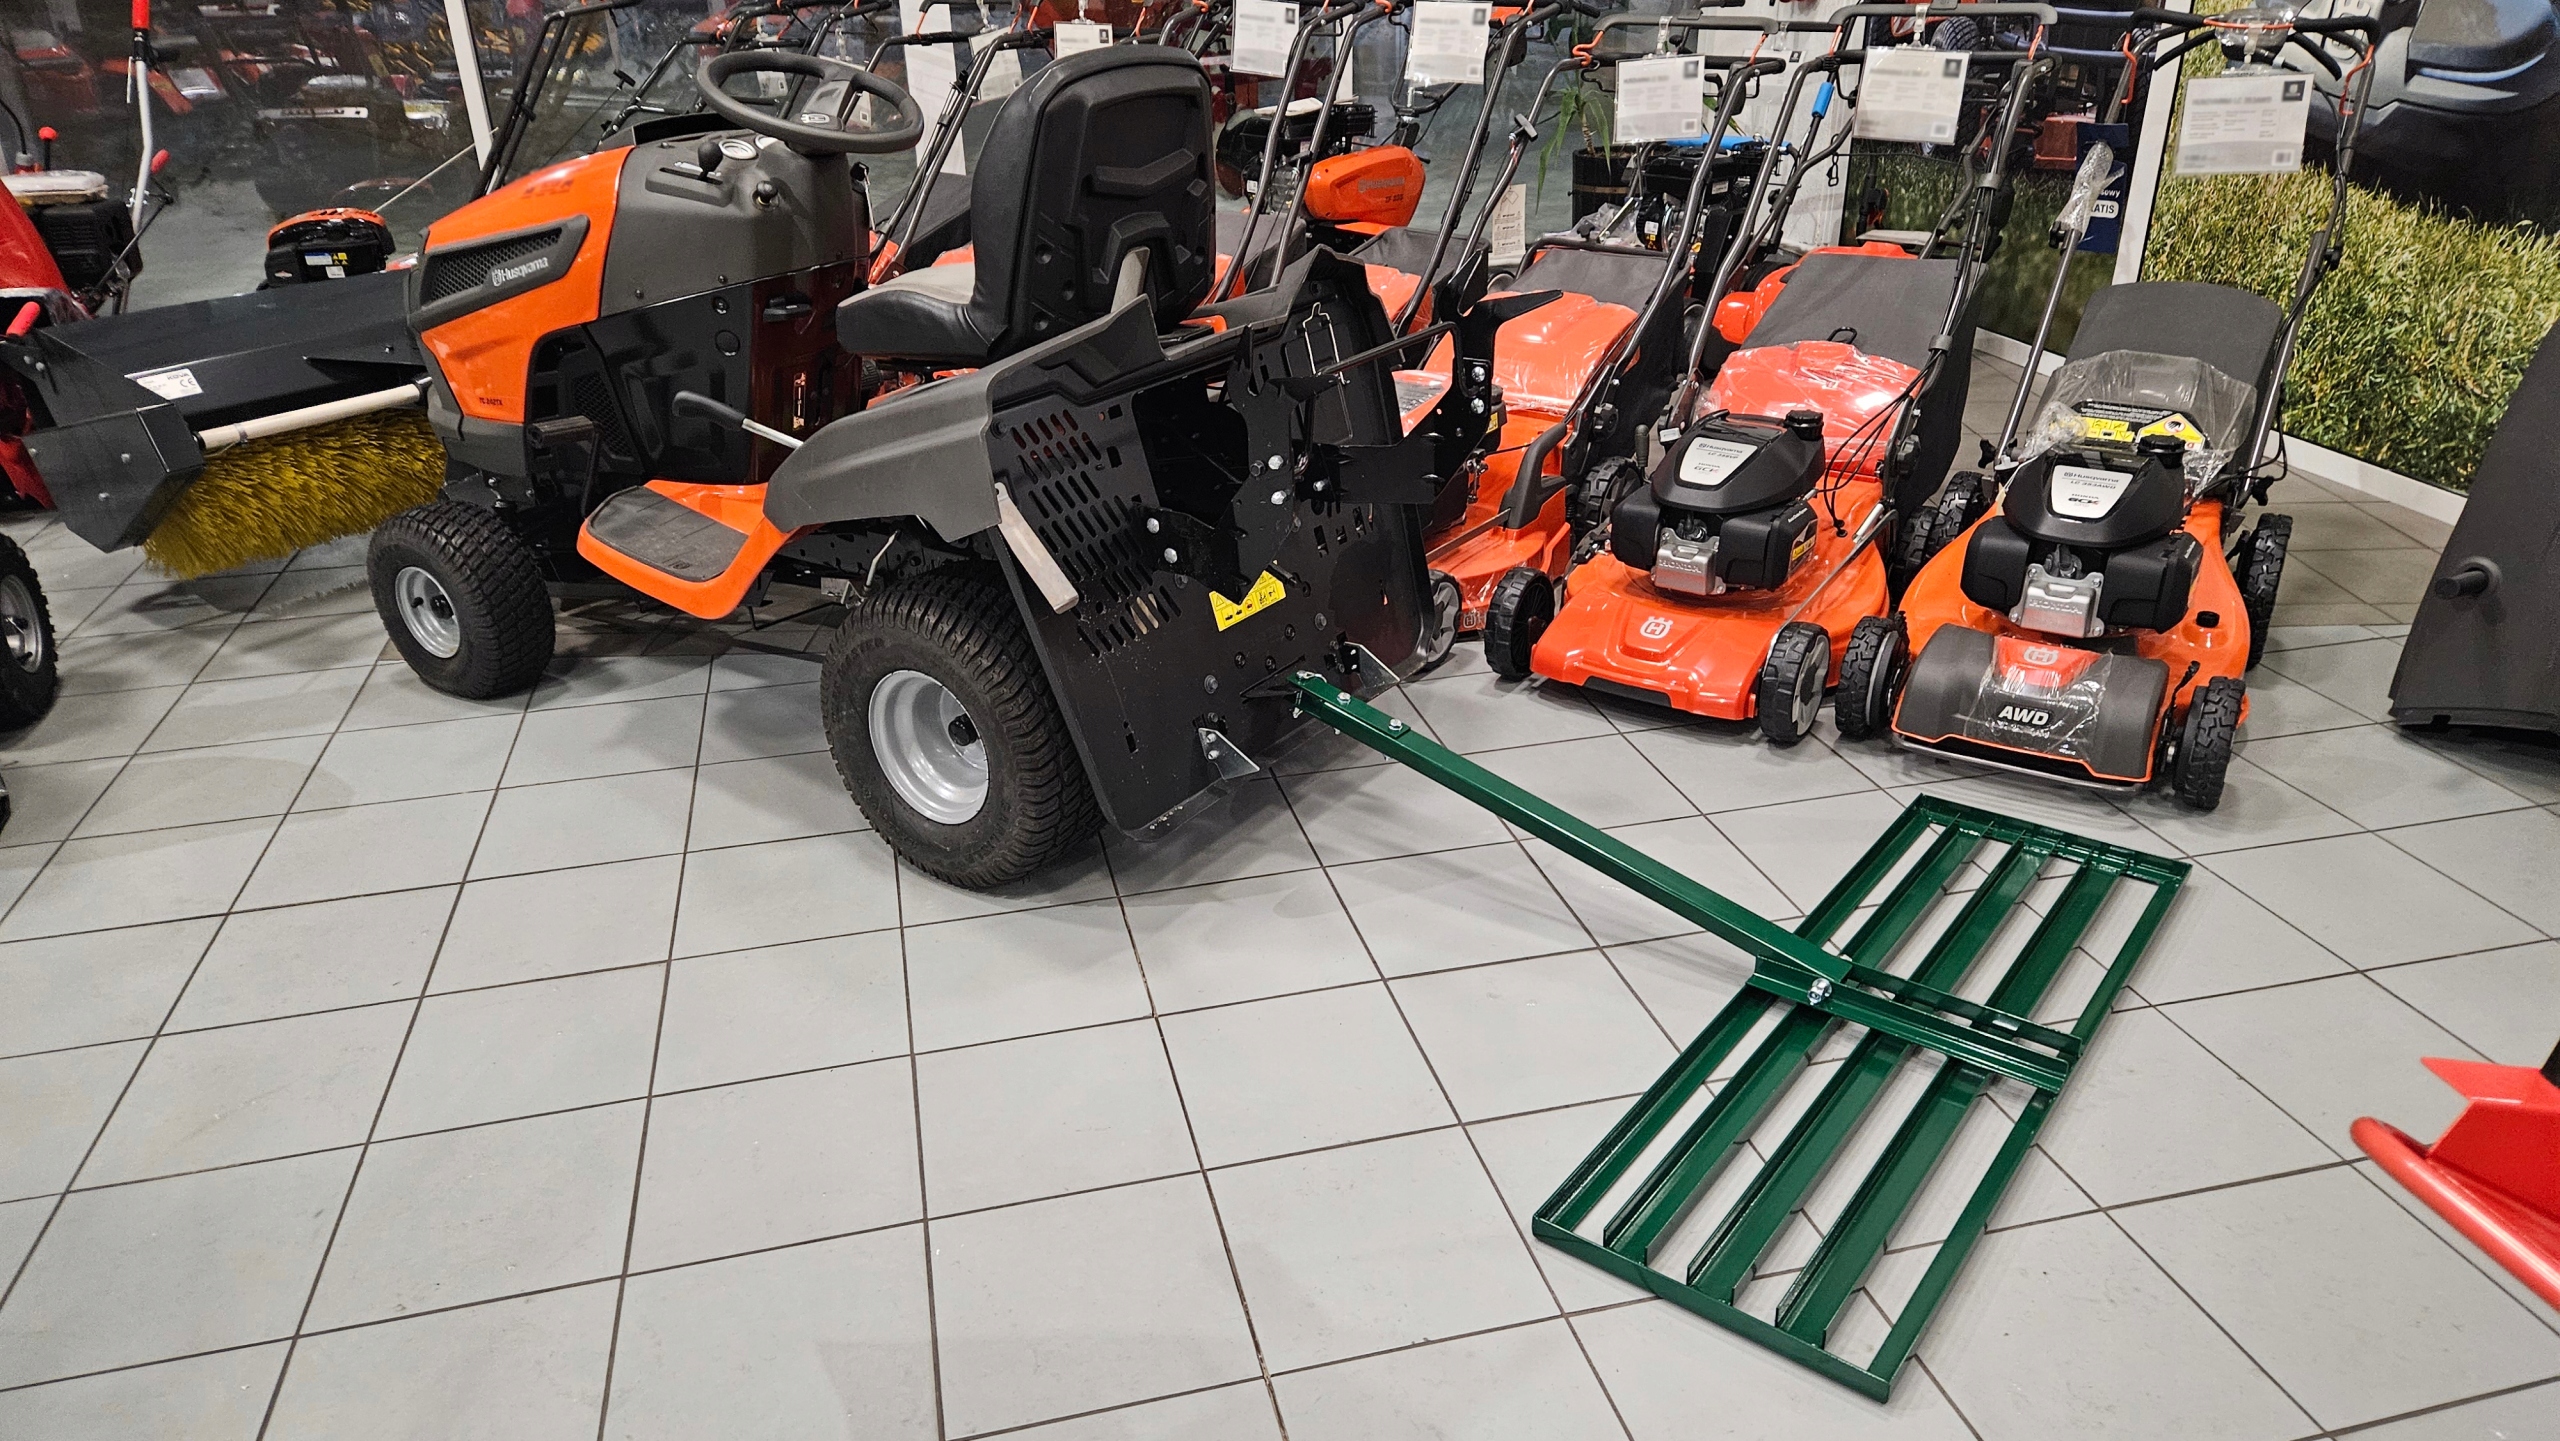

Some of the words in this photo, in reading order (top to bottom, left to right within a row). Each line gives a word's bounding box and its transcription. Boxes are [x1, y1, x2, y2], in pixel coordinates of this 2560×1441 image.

[2092, 204, 2115, 214] ATIS
[501, 257, 549, 282] Husqvarna
[2073, 472, 2119, 483] Husqvarna
[1659, 559, 1702, 574] HONDA
[2028, 599, 2083, 615] HONDA
[1998, 705, 2050, 726] AWD
